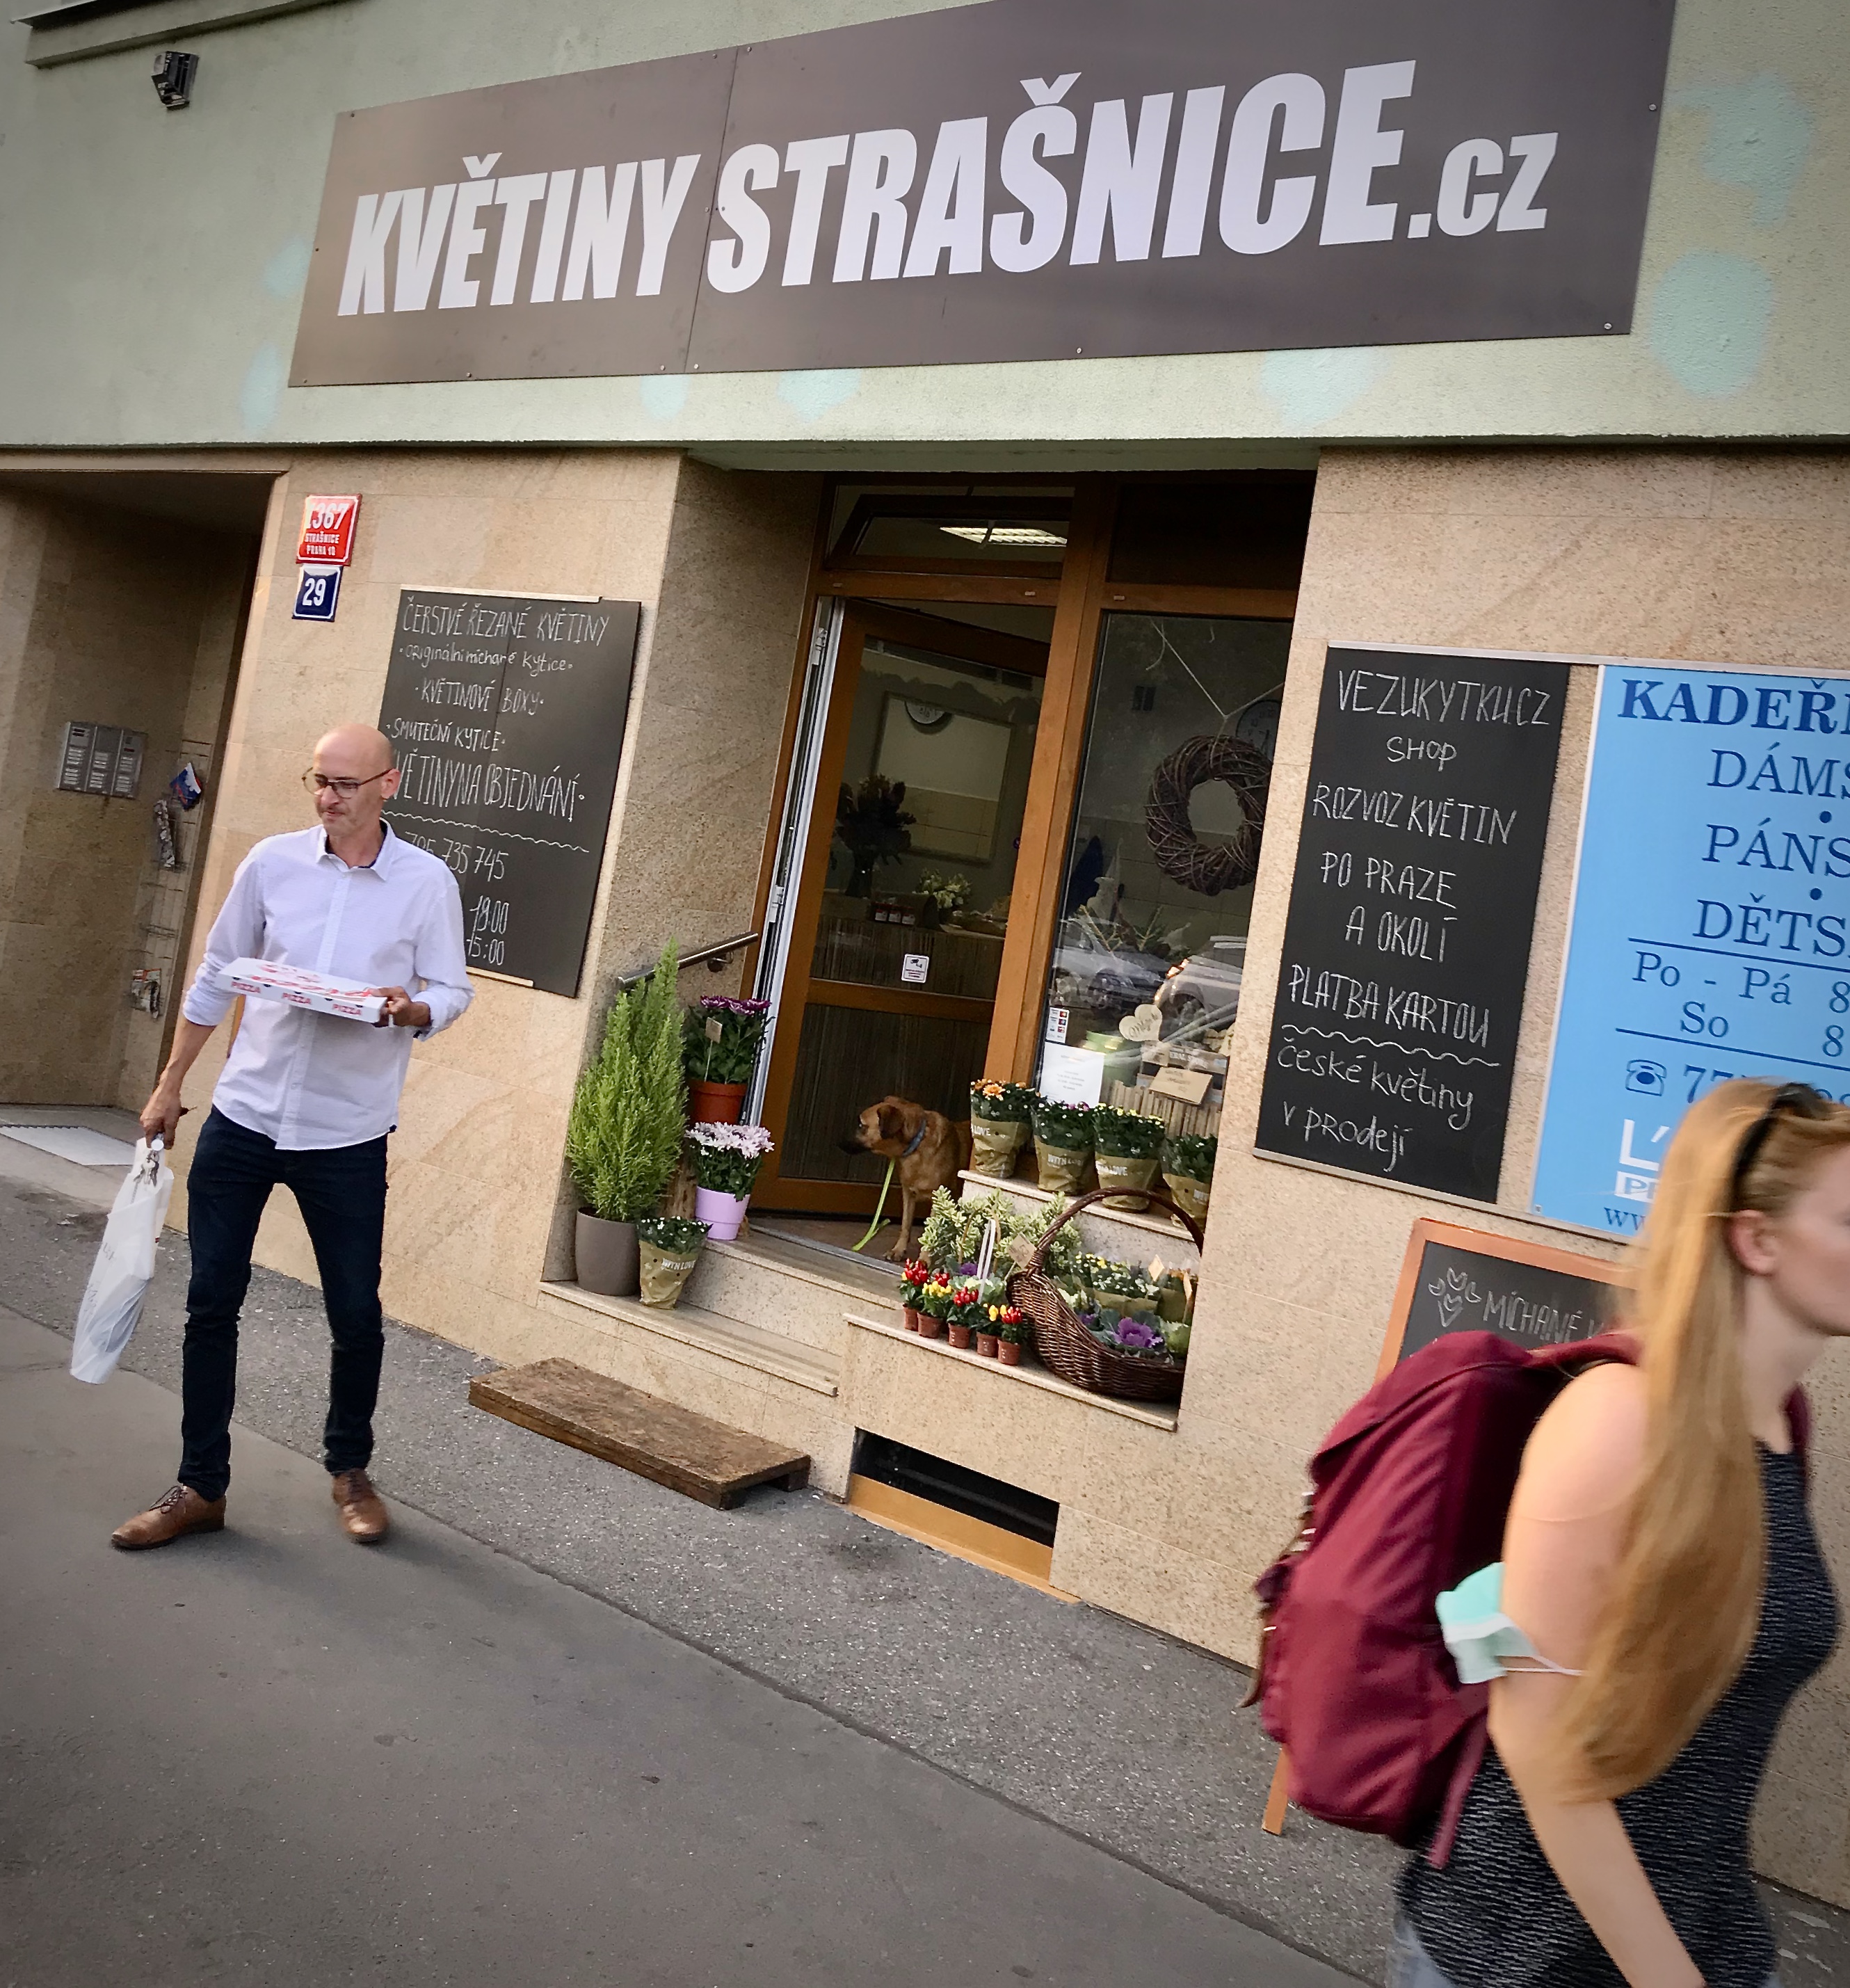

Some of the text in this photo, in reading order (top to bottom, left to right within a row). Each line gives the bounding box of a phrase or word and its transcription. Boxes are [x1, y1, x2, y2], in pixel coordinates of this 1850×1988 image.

[337, 152, 701, 316] KVĚTINY
[305, 531, 340, 544] STRAŠNICE
[306, 503, 349, 529] 1367
[306, 545, 336, 556] PRAHA 10
[302, 578, 326, 607] 29
[403, 595, 609, 646] ČERSTVÉ ŘEZANÉ KVĚTINY
[421, 679, 496, 712] KVĚTINOVÉ
[454, 726, 502, 752] KYTICE
[1387, 736, 1457, 771] SHOP
[394, 748, 460, 808] VĚTINY
[1707, 742, 1850, 799] DÁM
[1313, 782, 1517, 845] ROZVOZ KVĚTIN
[442, 837, 472, 874] 735
[475, 846, 508, 882] 745
[1321, 851, 1457, 909] PO PRAZE
[1345, 906, 1457, 963] A OKOLÍ
[1692, 892, 1850, 958] DĚTS
[231, 981, 261, 994] PIZZA
[282, 993, 312, 1004] PIZZA
[1289, 963, 1489, 1048] PLATBA KARTOU
[1632, 951, 1680, 987] Po
[1739, 966, 1792, 1005] Pá
[1829, 981, 1850, 1013] 8
[332, 1004, 362, 1016] PIZZA
[1680, 1001, 1844, 1057] So 8
[1371, 1061, 1473, 1130] květiny
